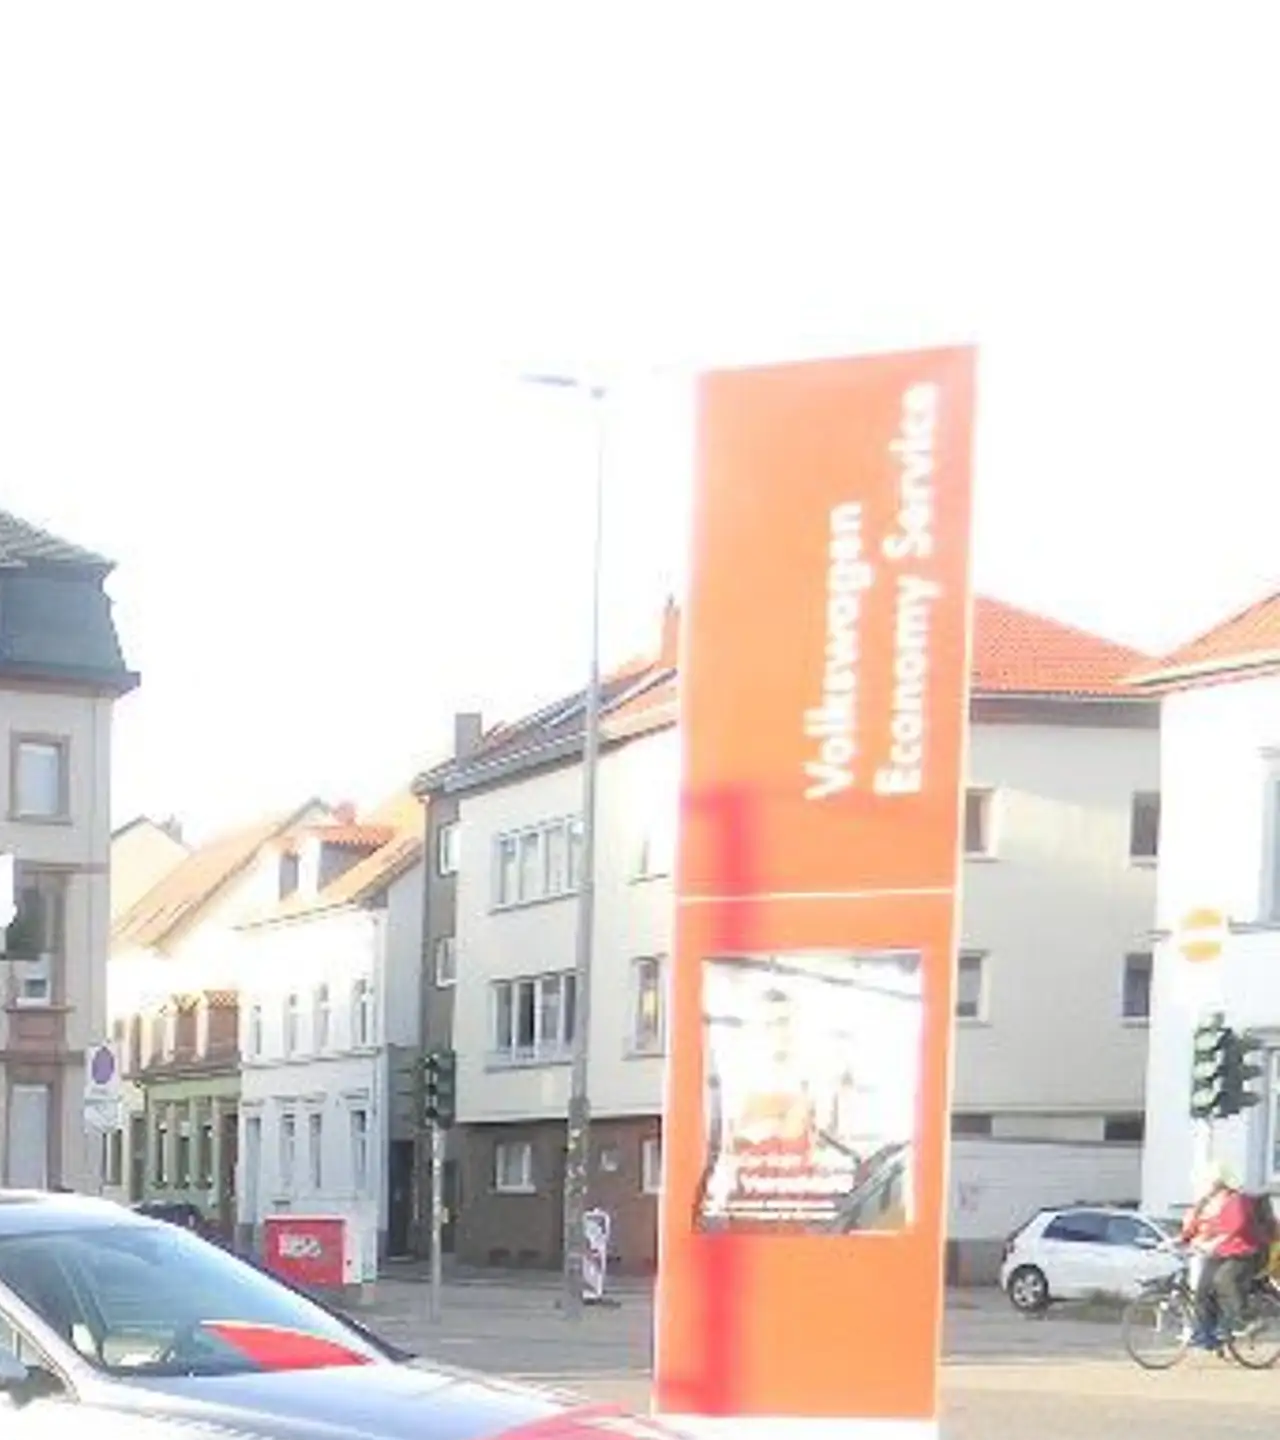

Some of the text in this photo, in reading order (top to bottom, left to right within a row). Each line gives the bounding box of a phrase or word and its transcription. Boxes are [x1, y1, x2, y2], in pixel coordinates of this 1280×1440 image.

[803, 501, 875, 800] Volkswagen
[872, 380, 943, 797] Economy Service
